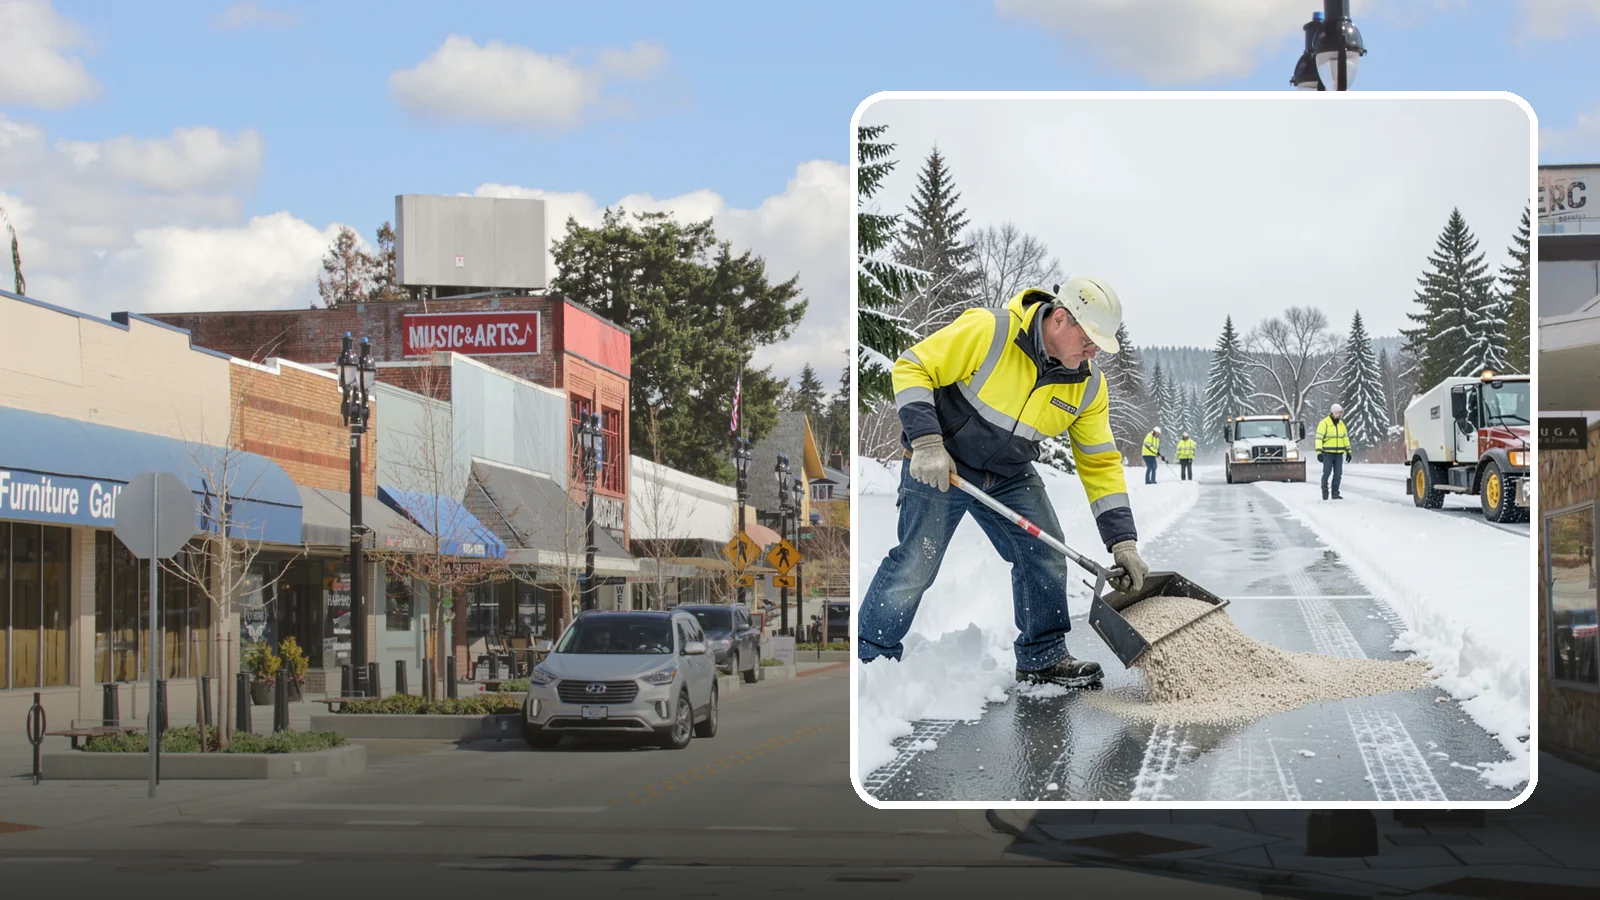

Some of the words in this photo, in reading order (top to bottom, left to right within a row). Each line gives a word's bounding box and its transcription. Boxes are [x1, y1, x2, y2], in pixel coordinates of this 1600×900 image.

[0, 472, 79, 515] Furniture
[90, 482, 121, 519] Gal
[454, 564, 479, 574] SUSHI
